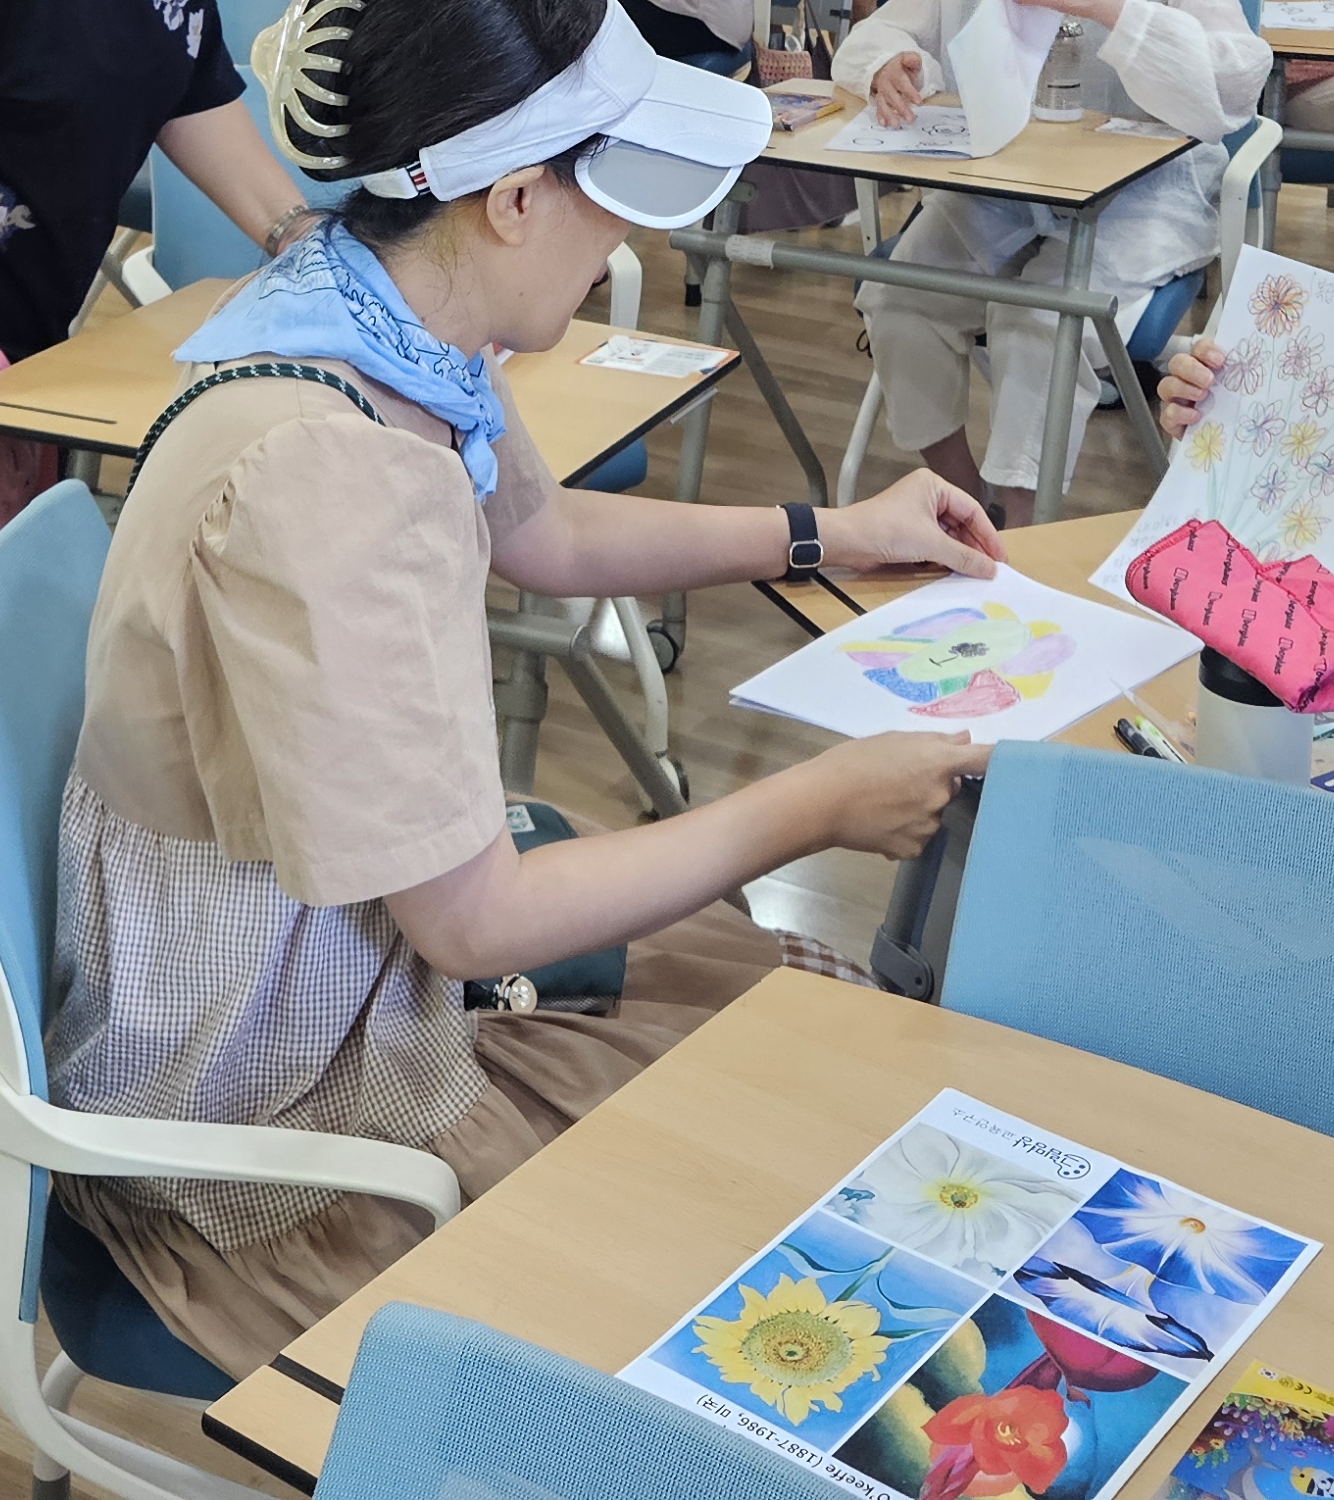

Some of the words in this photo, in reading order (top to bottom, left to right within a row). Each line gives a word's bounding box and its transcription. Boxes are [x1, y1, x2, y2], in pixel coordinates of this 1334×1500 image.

[1142, 557, 1152, 590] erghaus
[1221, 548, 1236, 586] berghaus
[953, 1108, 1017, 1141] 교육연구소
[1013, 1136, 1072, 1169] 그림명상
[696, 1392, 732, 1419] 미국)
[738, 1413, 824, 1469] (1887-1986,
